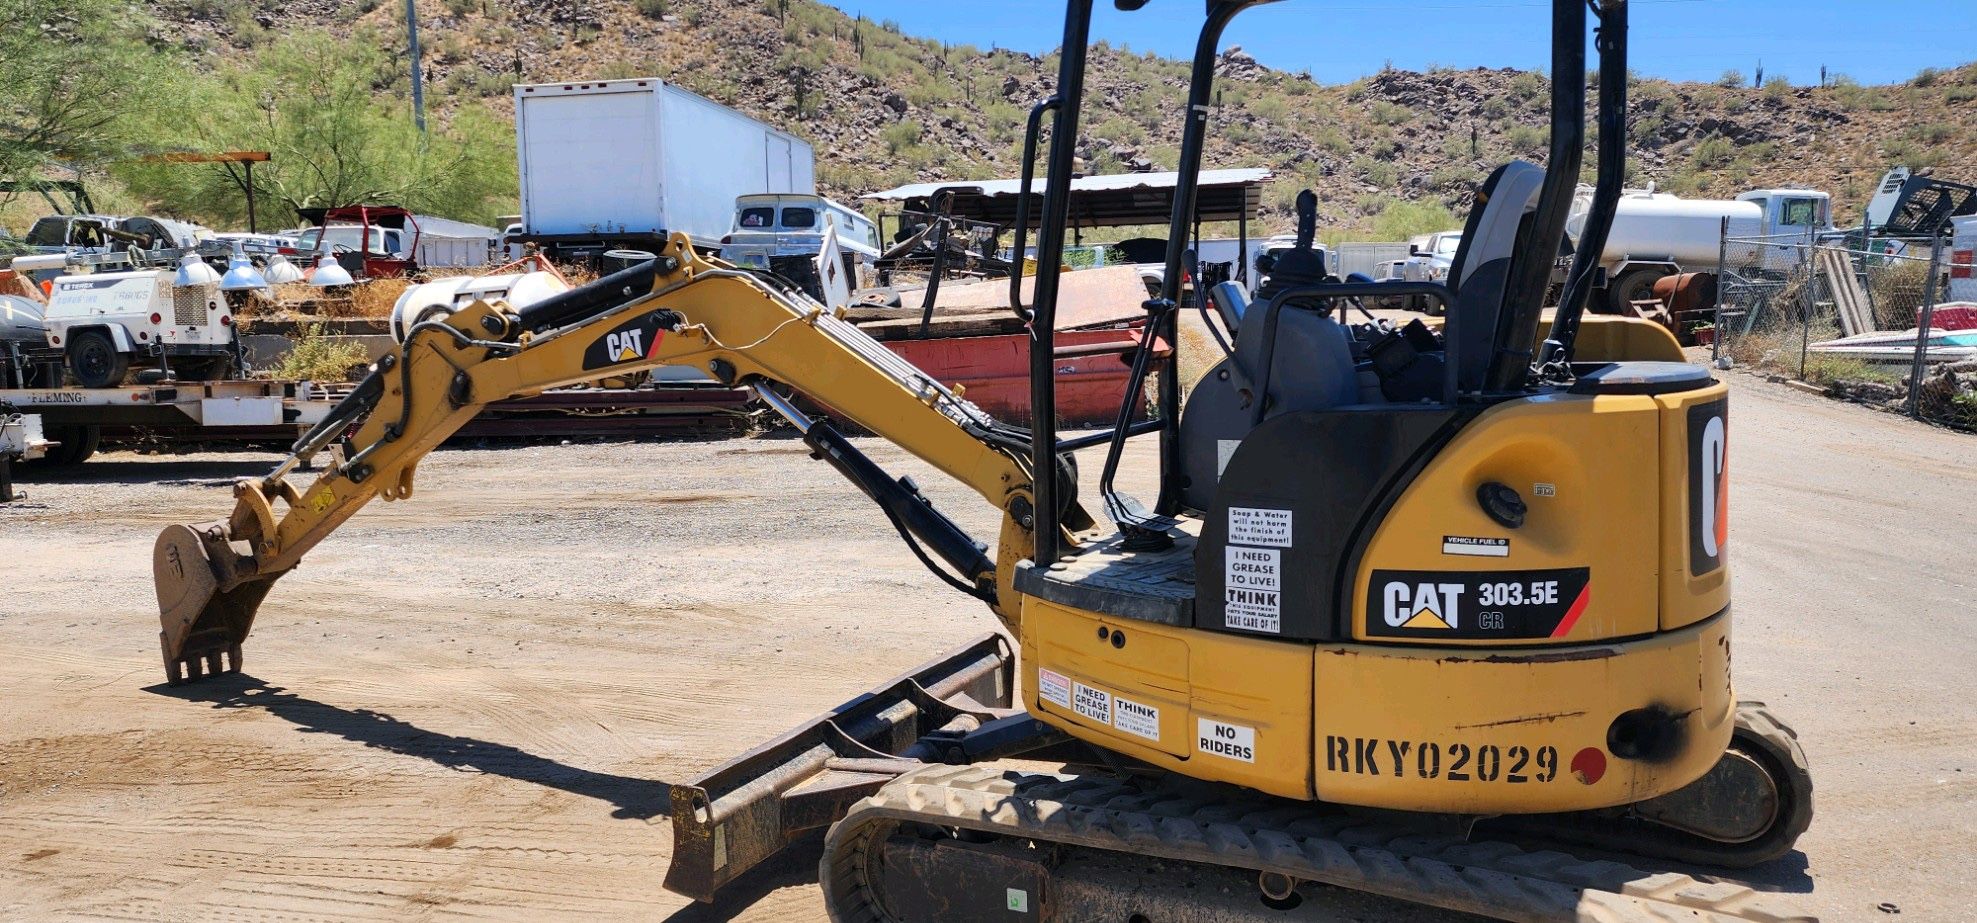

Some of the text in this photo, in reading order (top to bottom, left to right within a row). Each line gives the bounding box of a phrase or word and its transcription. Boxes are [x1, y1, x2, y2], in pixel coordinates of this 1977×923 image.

[606, 328, 643, 362] CAT
[32, 392, 82, 403] FLEMING
[1232, 510, 1251, 518] Soap
[1251, 527, 1273, 535] finish
[1266, 520, 1287, 528] harm
[1447, 537, 1478, 545] VEHICLE
[1479, 538, 1497, 546] FUEL
[1235, 551, 1271, 562] I NEED
[1232, 562, 1275, 575] GREASE
[1231, 575, 1275, 587] TO LIVE!
[1228, 589, 1277, 607] THINK
[1478, 580, 1559, 607] 303.5E
[1383, 581, 1465, 629] CAT
[1227, 615, 1279, 631] TAKE CARE OF IT!
[1478, 611, 1504, 630] CR
[1077, 685, 1081, 693] I
[1082, 686, 1105, 702] NEED
[1075, 694, 1108, 713] GREASE
[1116, 699, 1156, 719] THINK
[1075, 703, 1086, 714] TO
[1087, 708, 1109, 723] LIVE!
[1215, 725, 1236, 740] NO
[1200, 737, 1252, 759] RIDERS
[1326, 735, 1558, 783] RKY02029
